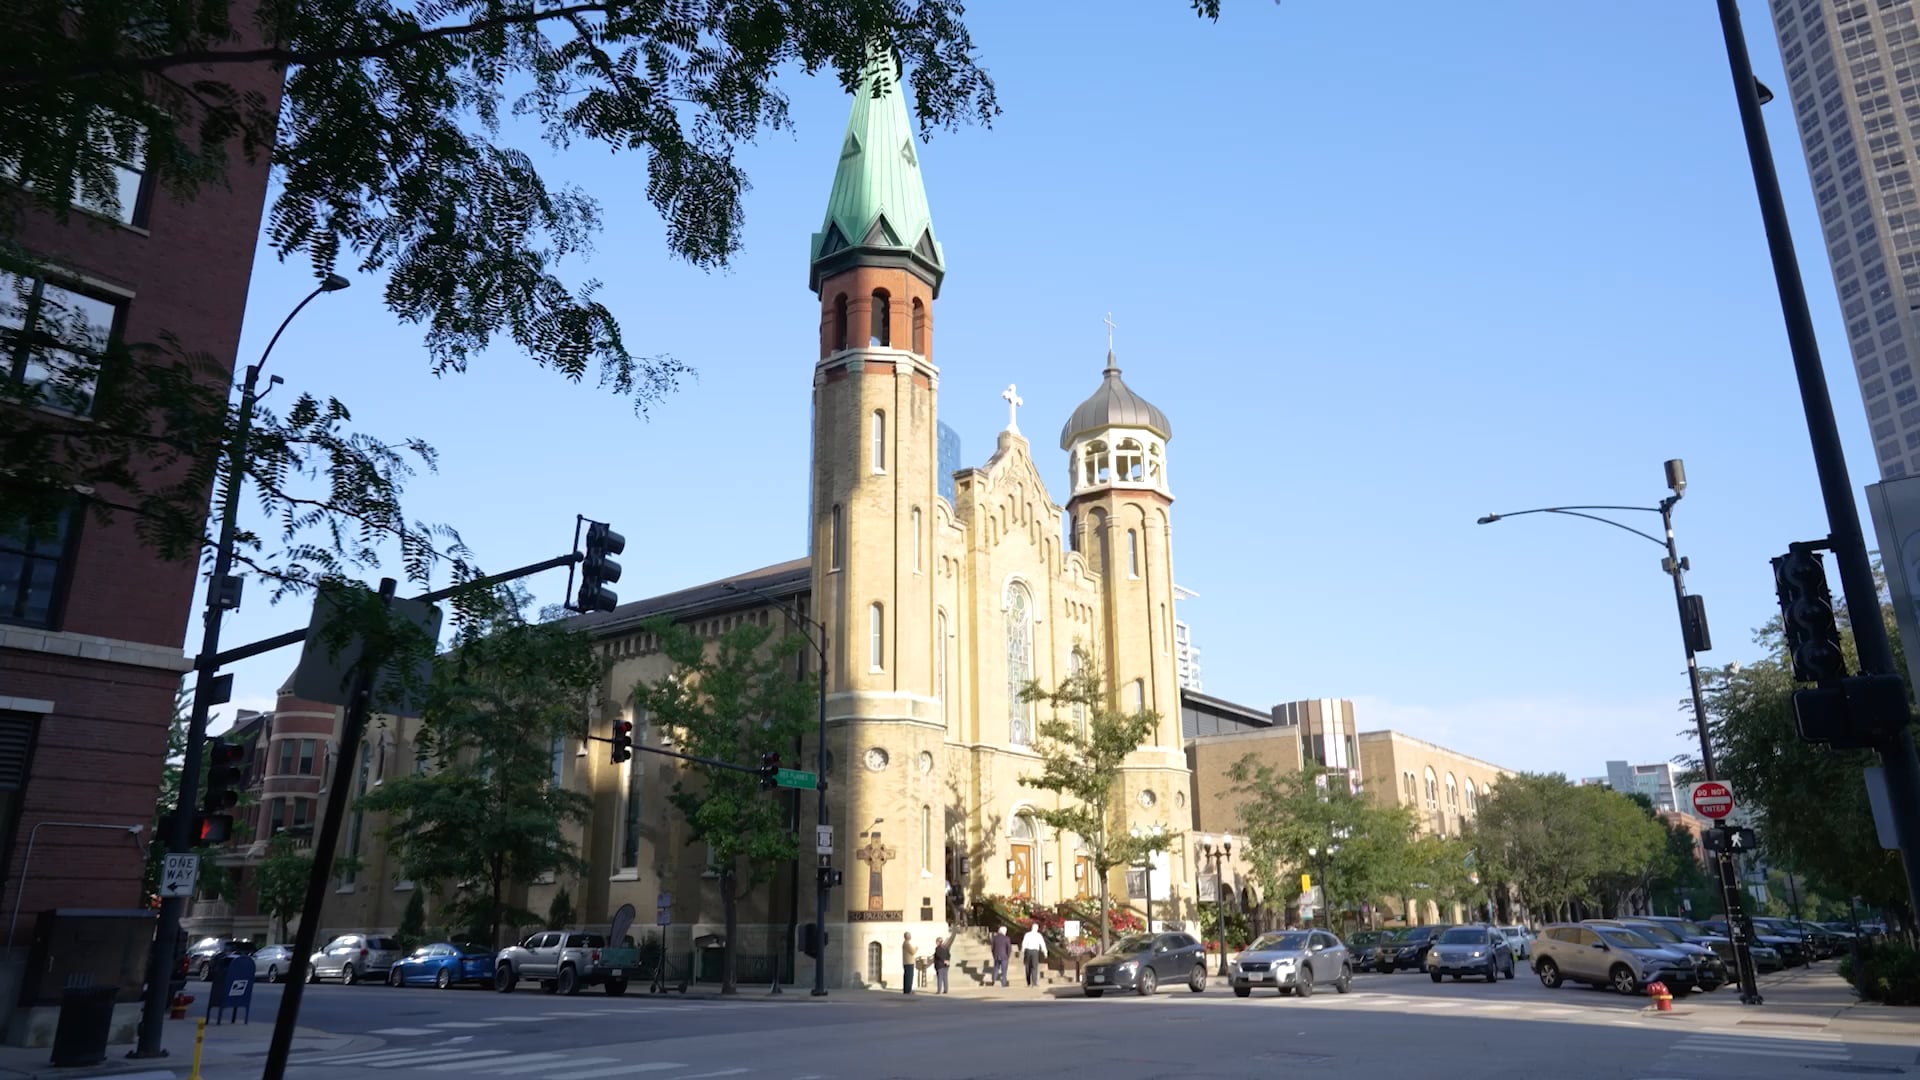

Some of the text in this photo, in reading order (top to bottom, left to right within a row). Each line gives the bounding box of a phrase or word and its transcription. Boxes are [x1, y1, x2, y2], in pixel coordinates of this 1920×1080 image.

[1697, 788, 1726, 797] DO NOT
[1703, 804, 1725, 813] ENTER
[169, 857, 194, 868] ONE
[167, 869, 193, 880] WAY
